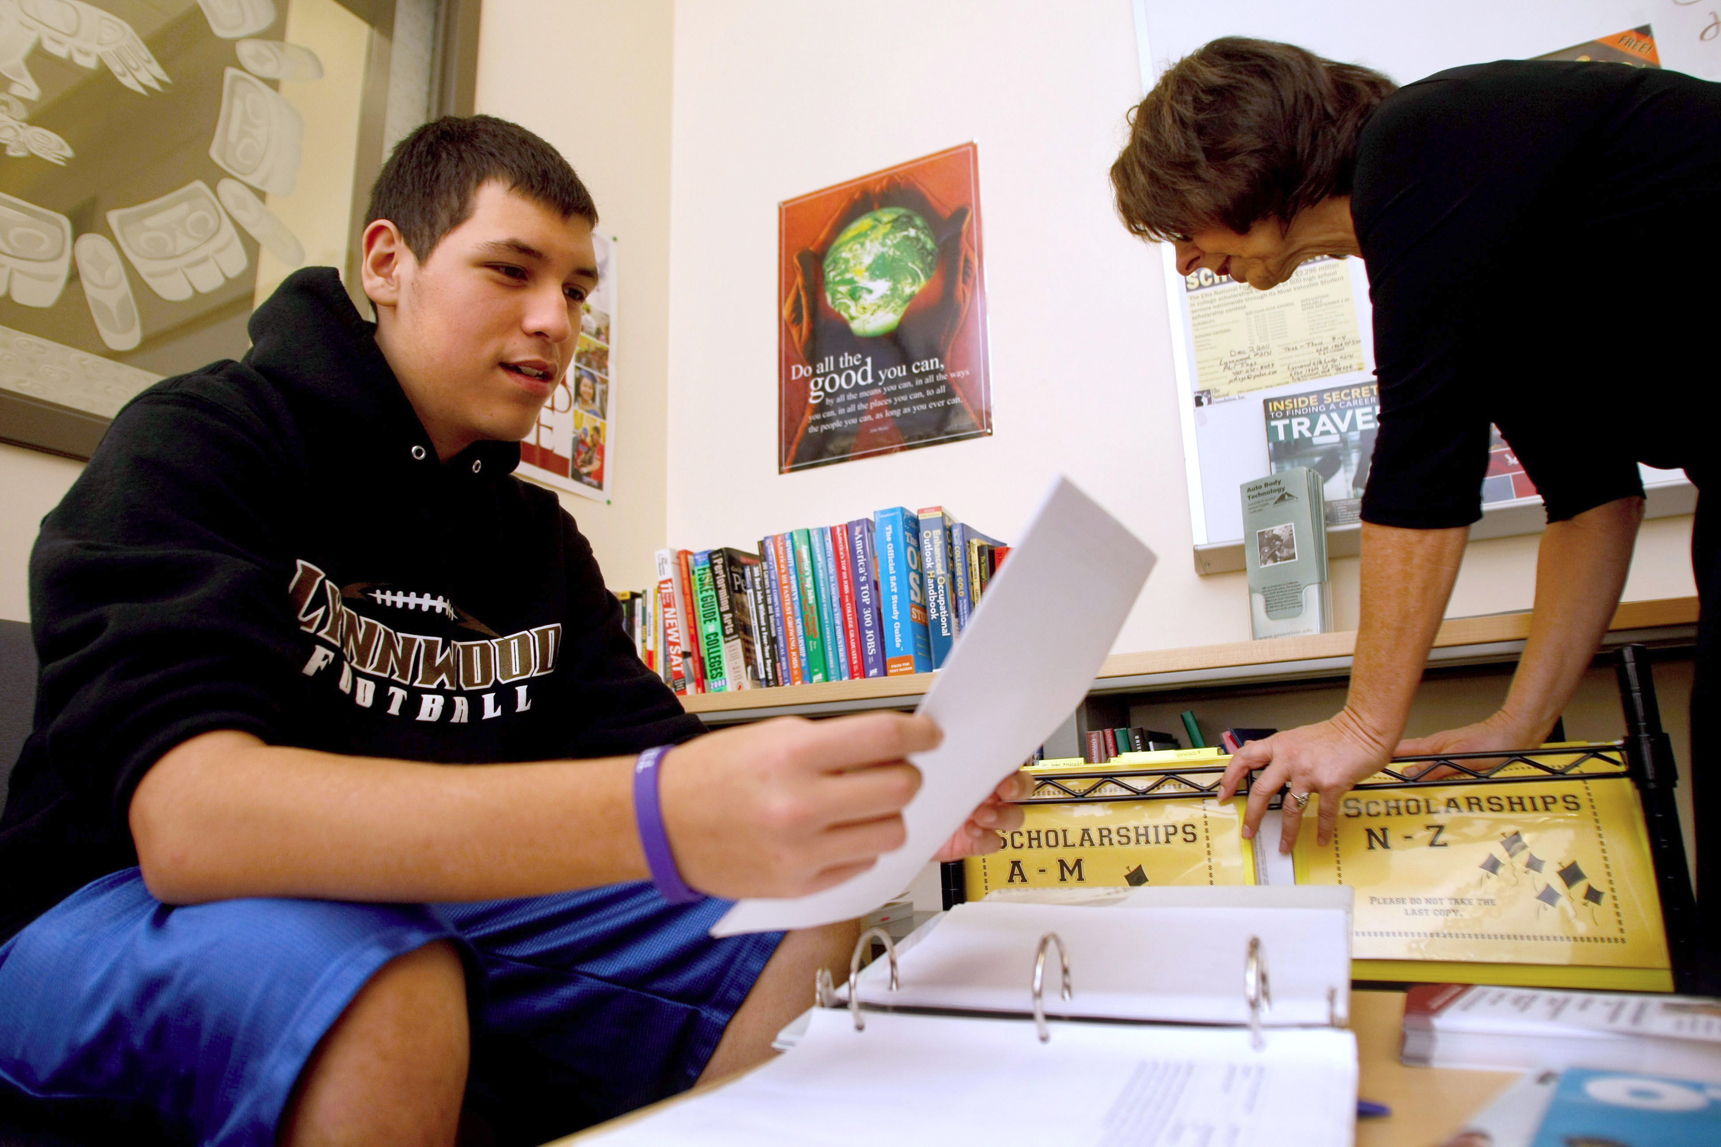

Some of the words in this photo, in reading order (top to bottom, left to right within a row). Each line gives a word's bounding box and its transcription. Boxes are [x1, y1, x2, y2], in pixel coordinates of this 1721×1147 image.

[791, 364, 812, 380] Do
[816, 357, 834, 374] all
[839, 352, 862, 370] the
[809, 356, 874, 404] good
[878, 364, 907, 385] you
[912, 356, 945, 374] can,
[836, 394, 846, 403] all
[847, 391, 858, 401] the
[859, 389, 882, 398] means
[883, 384, 897, 394] you
[915, 377, 923, 386] in
[924, 375, 934, 384] all
[935, 372, 948, 382] the
[808, 413, 821, 423] you
[838, 406, 846, 415] in
[847, 404, 856, 413] all
[857, 401, 869, 411] the
[869, 397, 893, 409] places
[893, 394, 908, 405] you
[926, 388, 935, 397] to
[936, 385, 946, 395] all
[808, 423, 819, 434] the
[820, 420, 843, 432] people
[843, 417, 858, 428] you
[875, 411, 884, 419] as
[885, 407, 901, 418] long
[902, 406, 911, 414] as
[912, 402, 927, 413] you
[928, 399, 945, 409] ever
[1268, 394, 1318, 413] INSIDE
[1271, 411, 1283, 419] TO
[1286, 404, 1326, 417] FINDING
[1339, 396, 1376, 409] CAREER
[1271, 405, 1380, 441] TRAVE
[1247, 484, 1263, 493] Auto
[1264, 480, 1281, 488] Body
[1247, 487, 1286, 500] Technology
[885, 525, 893, 541] The
[854, 533, 868, 581] America's
[886, 543, 895, 574] Official
[923, 530, 933, 568] Outlook
[931, 529, 944, 574] Enhanced
[953, 544, 963, 576] COLLEGE
[696, 566, 715, 593] FISKE
[860, 584, 870, 604] TOP
[926, 570, 939, 619] Handbook
[701, 593, 718, 625] GUIDE
[711, 556, 730, 612] Performing
[722, 613, 735, 635] Arts
[890, 594, 900, 620] Study
[934, 576, 950, 636] Occupational
[289, 559, 562, 691] LYNNWOOD
[664, 607, 682, 640] NEW
[863, 607, 872, 626] 300
[670, 641, 683, 671] SAT
[705, 631, 723, 680] COLLEGES
[865, 628, 876, 655] JOBS
[790, 650, 798, 668] JOBS
[302, 645, 532, 724] FOOTBALL
[1343, 794, 1581, 818] SCHOLARSHIPS
[1365, 827, 1391, 850] N
[1426, 824, 1448, 848] Z
[1008, 860, 1027, 883] A
[1057, 858, 1085, 882] M
[1369, 896, 1408, 906] PLEASE
[1410, 896, 1423, 906] DO
[1425, 897, 1445, 906] NOT
[1447, 897, 1474, 906] TAKE
[1476, 898, 1496, 907] THE
[1404, 908, 1430, 917] LAST
